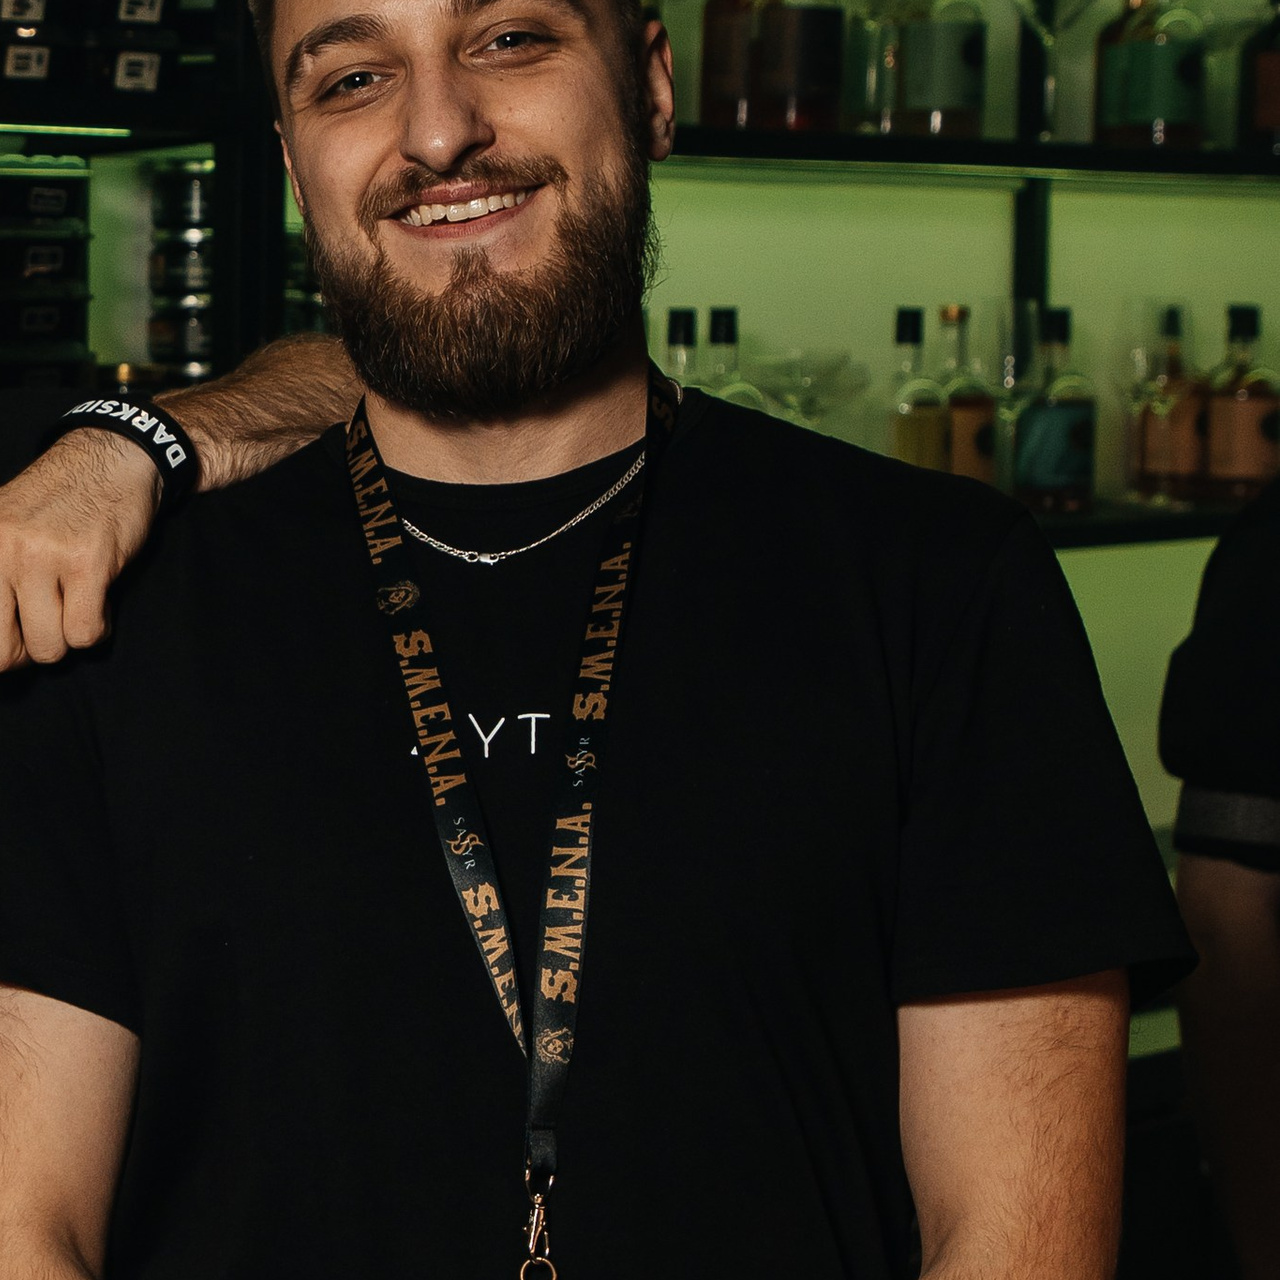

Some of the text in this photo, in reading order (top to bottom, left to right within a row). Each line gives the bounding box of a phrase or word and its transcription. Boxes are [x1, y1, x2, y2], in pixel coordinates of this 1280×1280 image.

[392, 628, 467, 807] S.M.E.N.A.
[573, 541, 632, 721] S.M.E.N.A.
[540, 802, 592, 1004] S.M.E.N.A.
